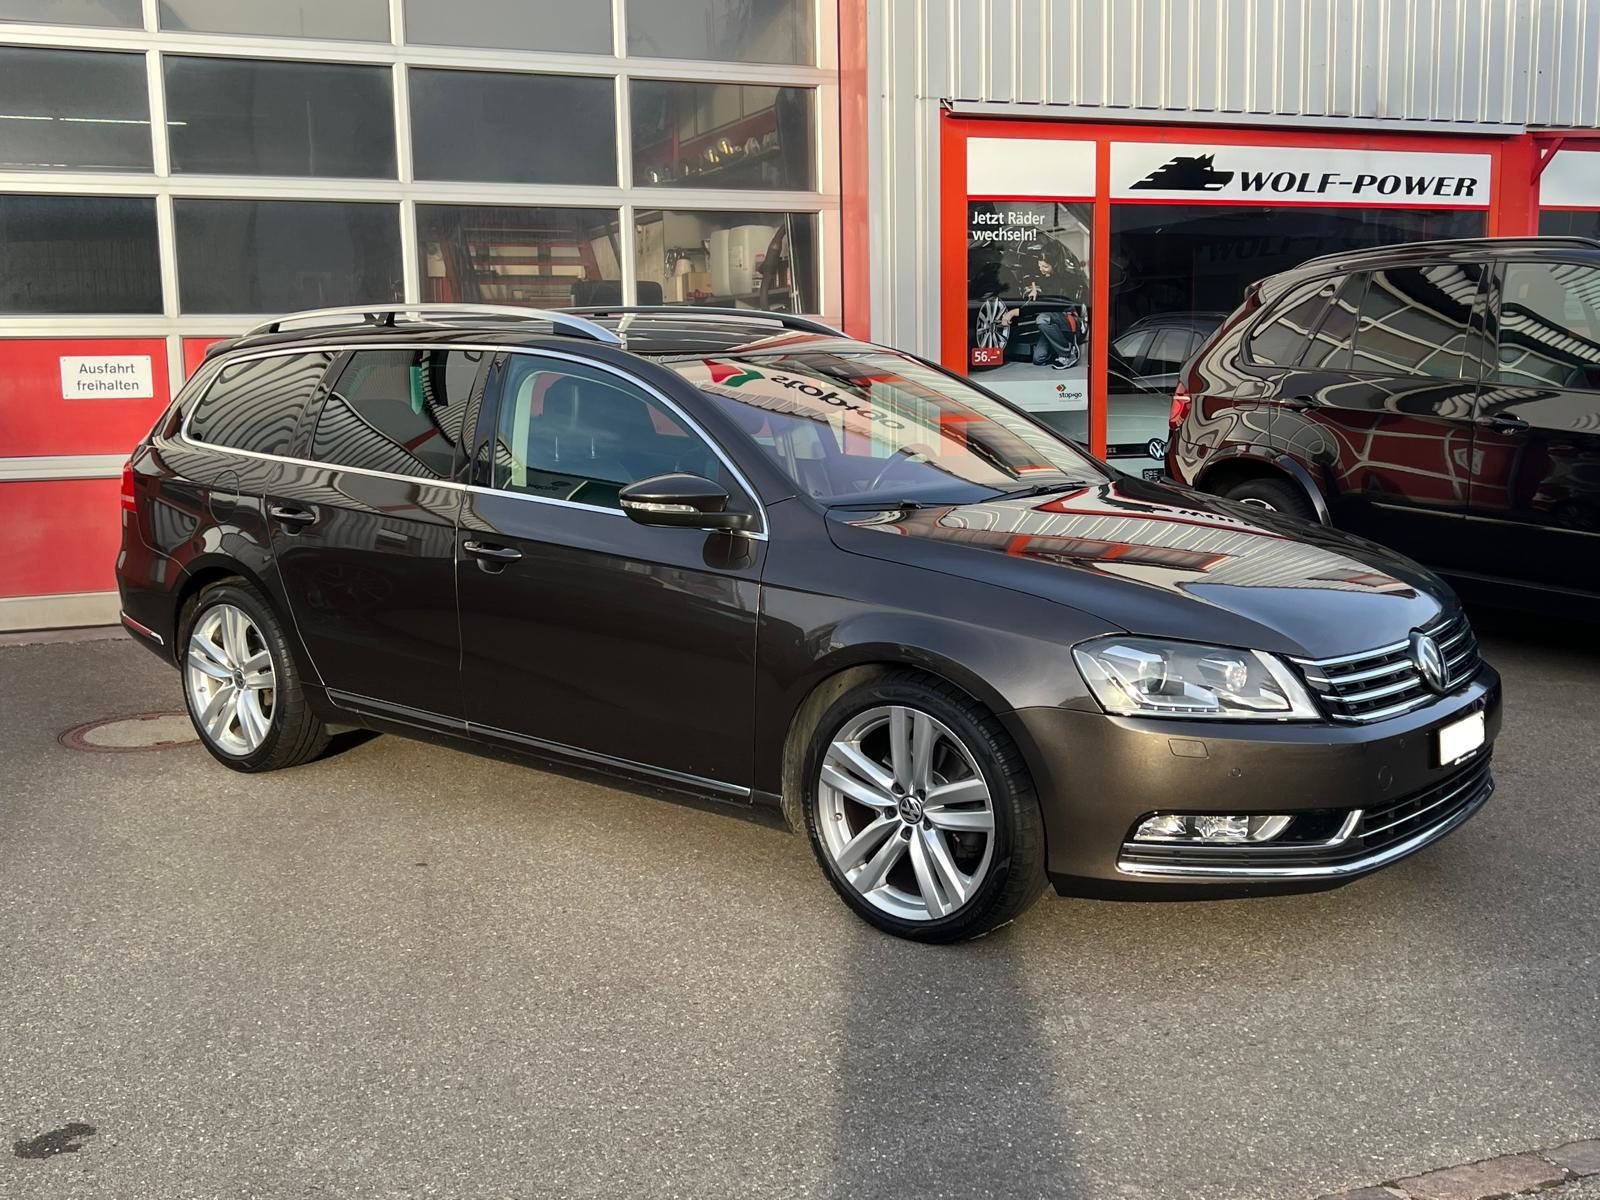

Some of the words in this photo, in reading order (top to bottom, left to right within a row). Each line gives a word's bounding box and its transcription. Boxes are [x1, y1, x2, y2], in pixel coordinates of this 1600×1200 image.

[1241, 171, 1478, 197] WOLF-POWER
[972, 211, 1004, 225] Jetzt
[1008, 211, 1045, 225] Räder
[972, 227, 1037, 241] wechseln!
[79, 363, 135, 374] Ausfahrt
[77, 380, 139, 391] freihalten
